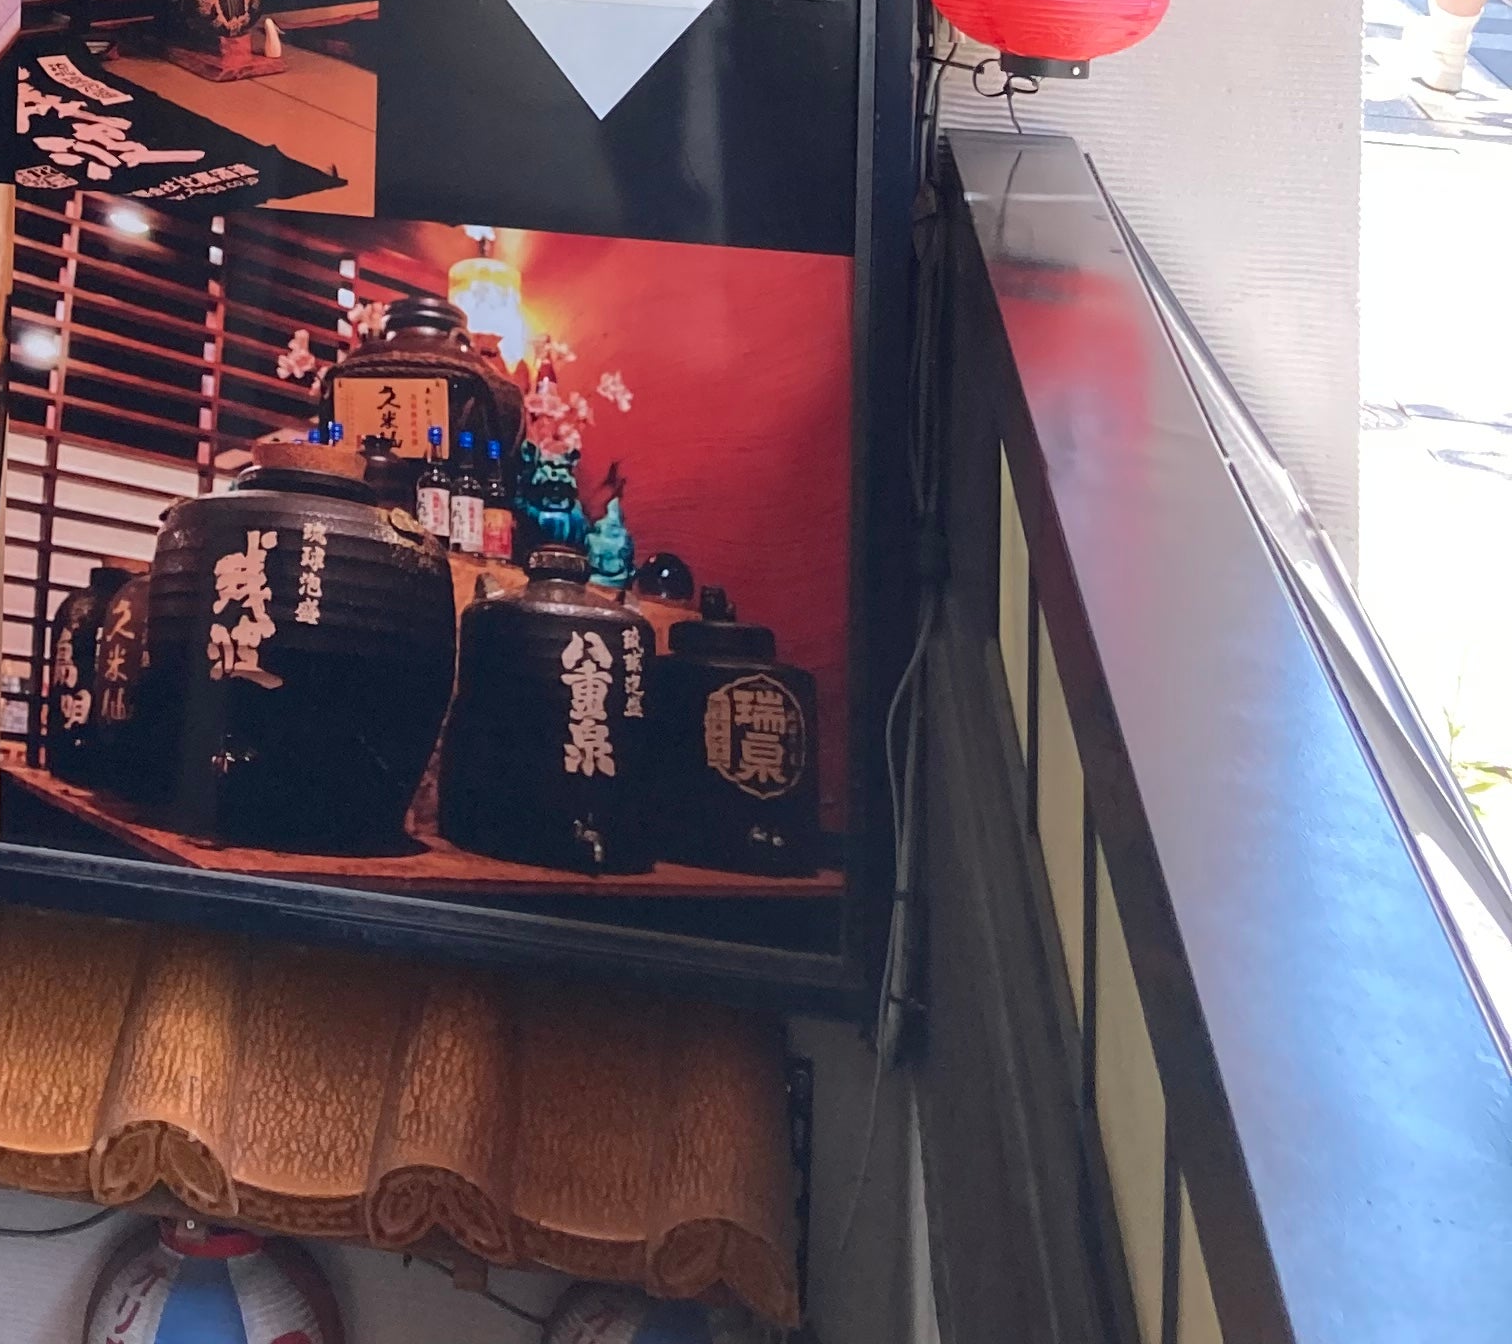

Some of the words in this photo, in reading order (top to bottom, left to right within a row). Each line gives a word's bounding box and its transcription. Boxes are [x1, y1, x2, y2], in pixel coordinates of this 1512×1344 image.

[377, 385, 403, 449] 久米仙
[102, 600, 137, 720] 久米仙
[207, 530, 284, 689] 残波
[561, 631, 615, 777] 八重泉
[733, 689, 787, 784] 瑞泉
[106, 1265, 168, 1344] オリ
